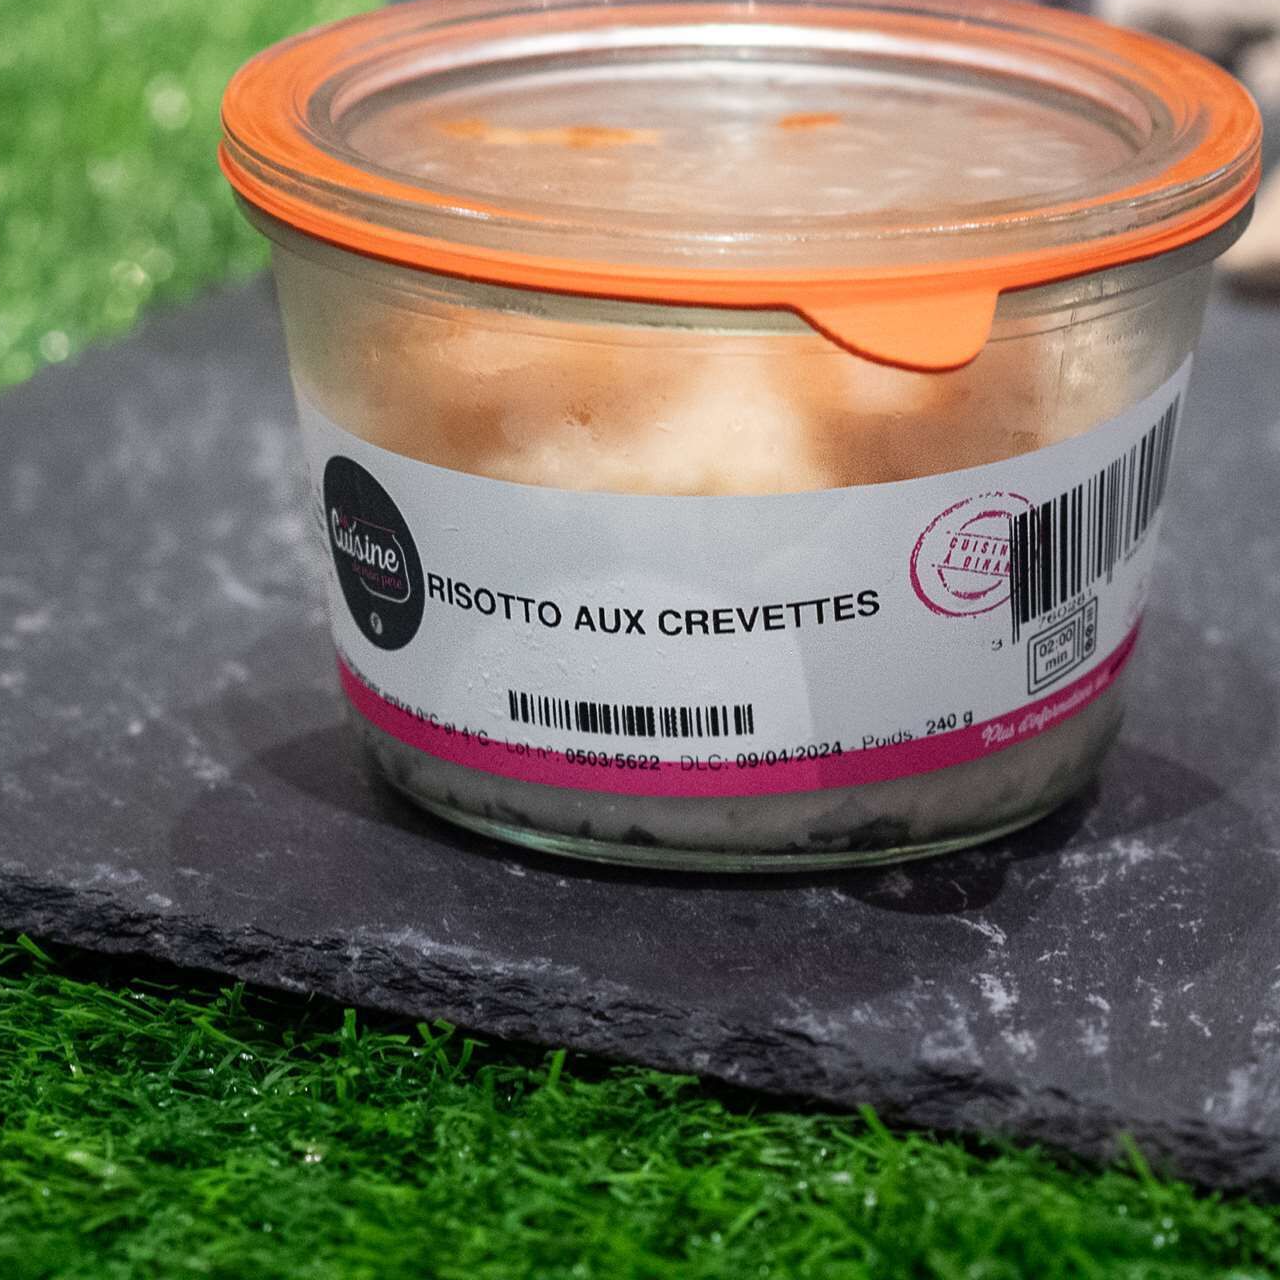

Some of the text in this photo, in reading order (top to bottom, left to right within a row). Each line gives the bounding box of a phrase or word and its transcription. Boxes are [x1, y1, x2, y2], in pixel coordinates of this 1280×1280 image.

[331, 507, 400, 574] Cuisine
[949, 536, 1009, 556] CUISIN
[962, 555, 1012, 574] DINAN
[426, 572, 881, 636] RISOTTO AUX CREVETTES
[1039, 627, 1074, 658] 02:00
[1045, 650, 1068, 672] min
[505, 736, 531, 757] Lot
[566, 748, 661, 772] 0503/5622
[680, 754, 729, 772] DLC:
[735, 740, 843, 770] 09/04/2024
[926, 712, 957, 735] 240
[962, 710, 975, 728] g
